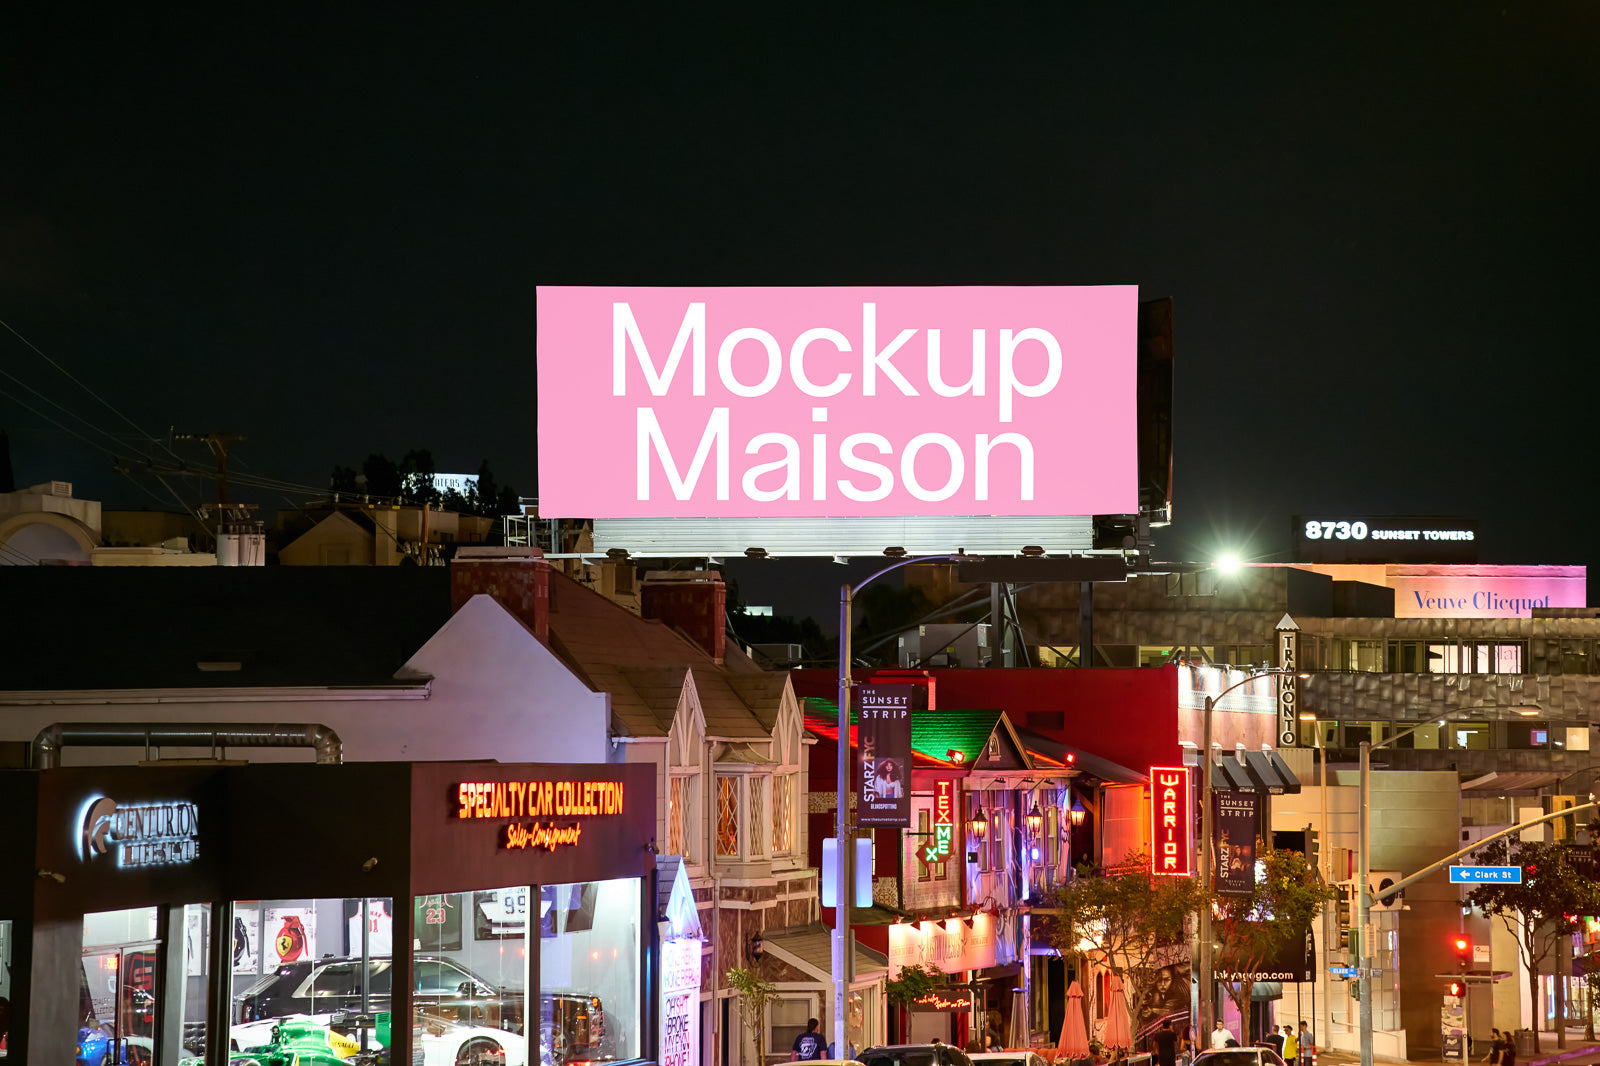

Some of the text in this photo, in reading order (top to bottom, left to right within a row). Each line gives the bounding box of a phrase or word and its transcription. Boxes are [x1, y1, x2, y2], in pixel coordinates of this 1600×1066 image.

[611, 301, 1063, 423] Mockup
[636, 407, 1034, 502] Maison
[1305, 521, 1475, 541] 8730 SUNSET TOWERS
[1414, 590, 1551, 614] Veuve Clicquot
[862, 696, 908, 704] SUNSET
[1281, 635, 1295, 744] TRAMONTO
[862, 710, 907, 719] STRIP
[863, 736, 875, 802] STARZ FYC
[459, 781, 623, 818] SPECIALTY CAR COLLECTION
[1220, 799, 1254, 807] SUNSET
[115, 804, 199, 841] CENTURION
[1160, 773, 1179, 870] WARRIOR
[1220, 809, 1254, 817] STRIP
[1219, 847, 1230, 878] STARZ
[1474, 870, 1512, 879] Clark St
[426, 908, 446, 925] 23
[667, 1014, 689, 1036] BROKE
